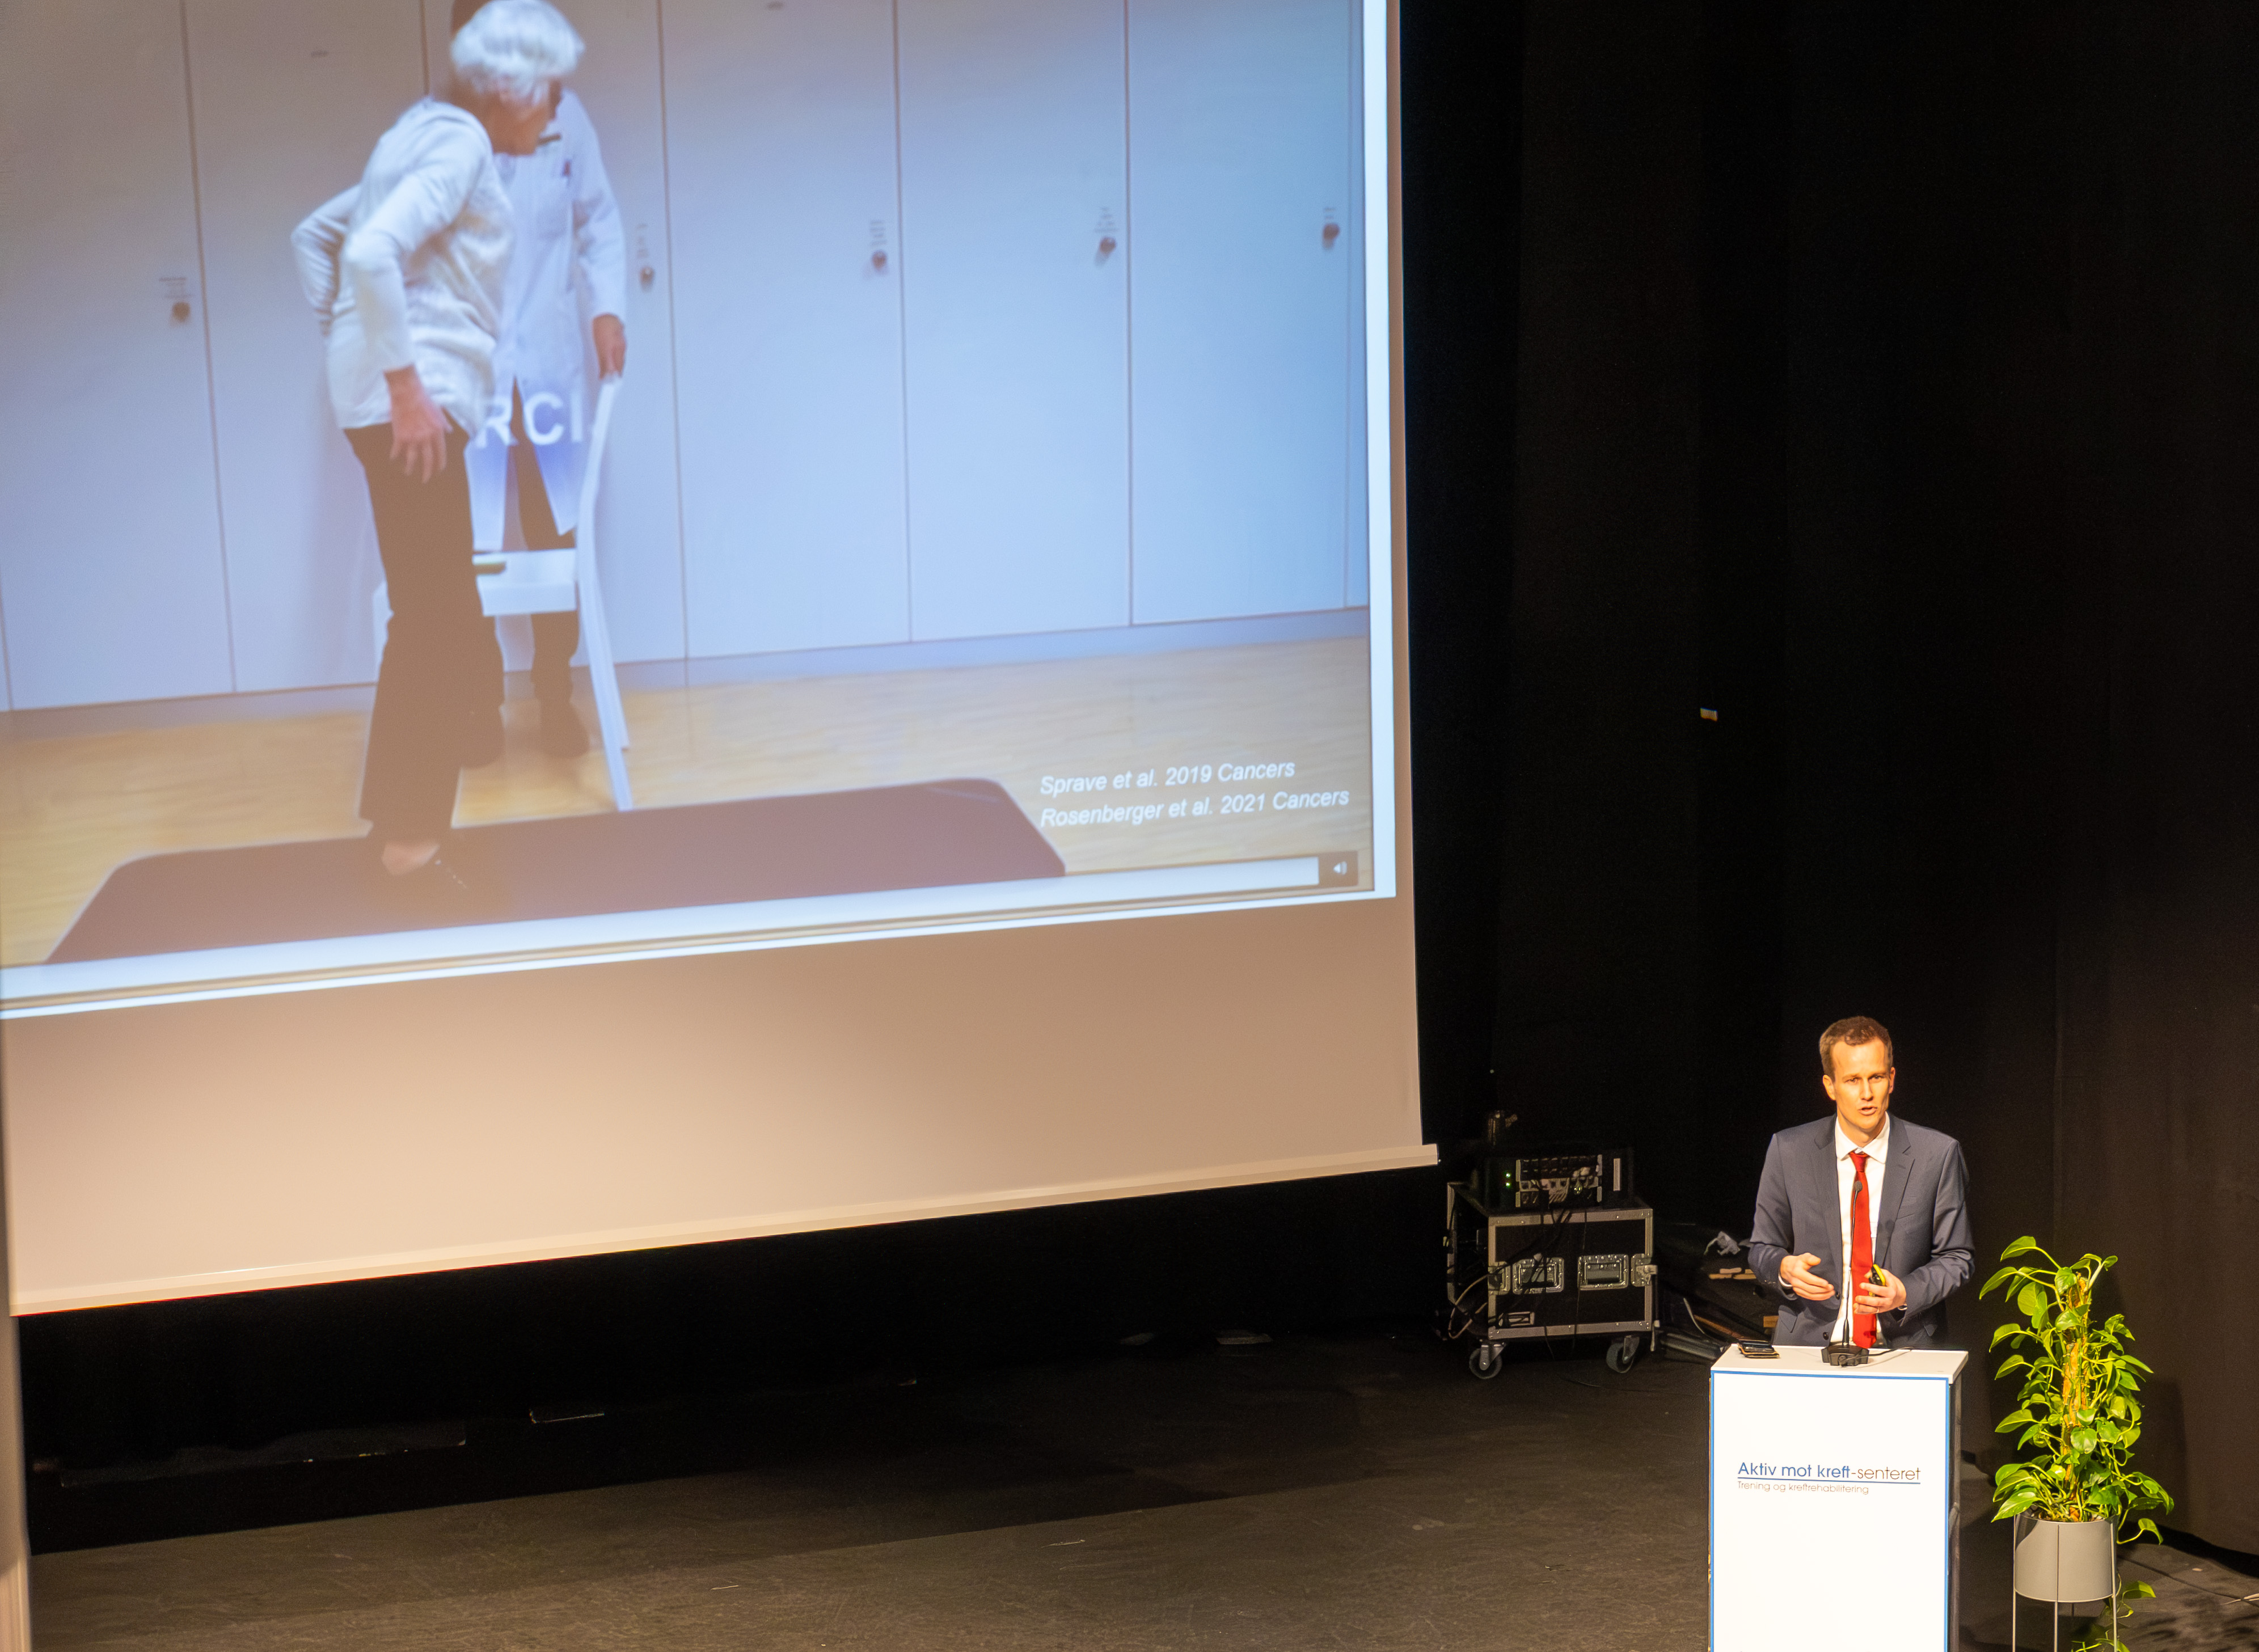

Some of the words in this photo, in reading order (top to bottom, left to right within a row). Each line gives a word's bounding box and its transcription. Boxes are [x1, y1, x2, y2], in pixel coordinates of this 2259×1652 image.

[1040, 772, 1108, 798] Sprave
[1112, 771, 1133, 789] et
[1136, 768, 1158, 788] al.
[1165, 764, 1212, 787] 2019
[1217, 762, 1296, 782] Cancers
[1040, 801, 1165, 828] Rosenberger
[1168, 798, 1188, 818] et
[1192, 797, 1213, 816] al.
[1220, 793, 1266, 814] 2021
[1272, 789, 1350, 810] Cancers
[1738, 1462, 1777, 1476] Aktiv
[1781, 1464, 1812, 1477] mot
[1817, 1465, 1921, 1480] kreft-senteret
[1737, 1481, 1771, 1492] Trening
[1773, 1484, 1786, 1493] og
[1789, 1483, 1869, 1495] kreftrehabilitering
